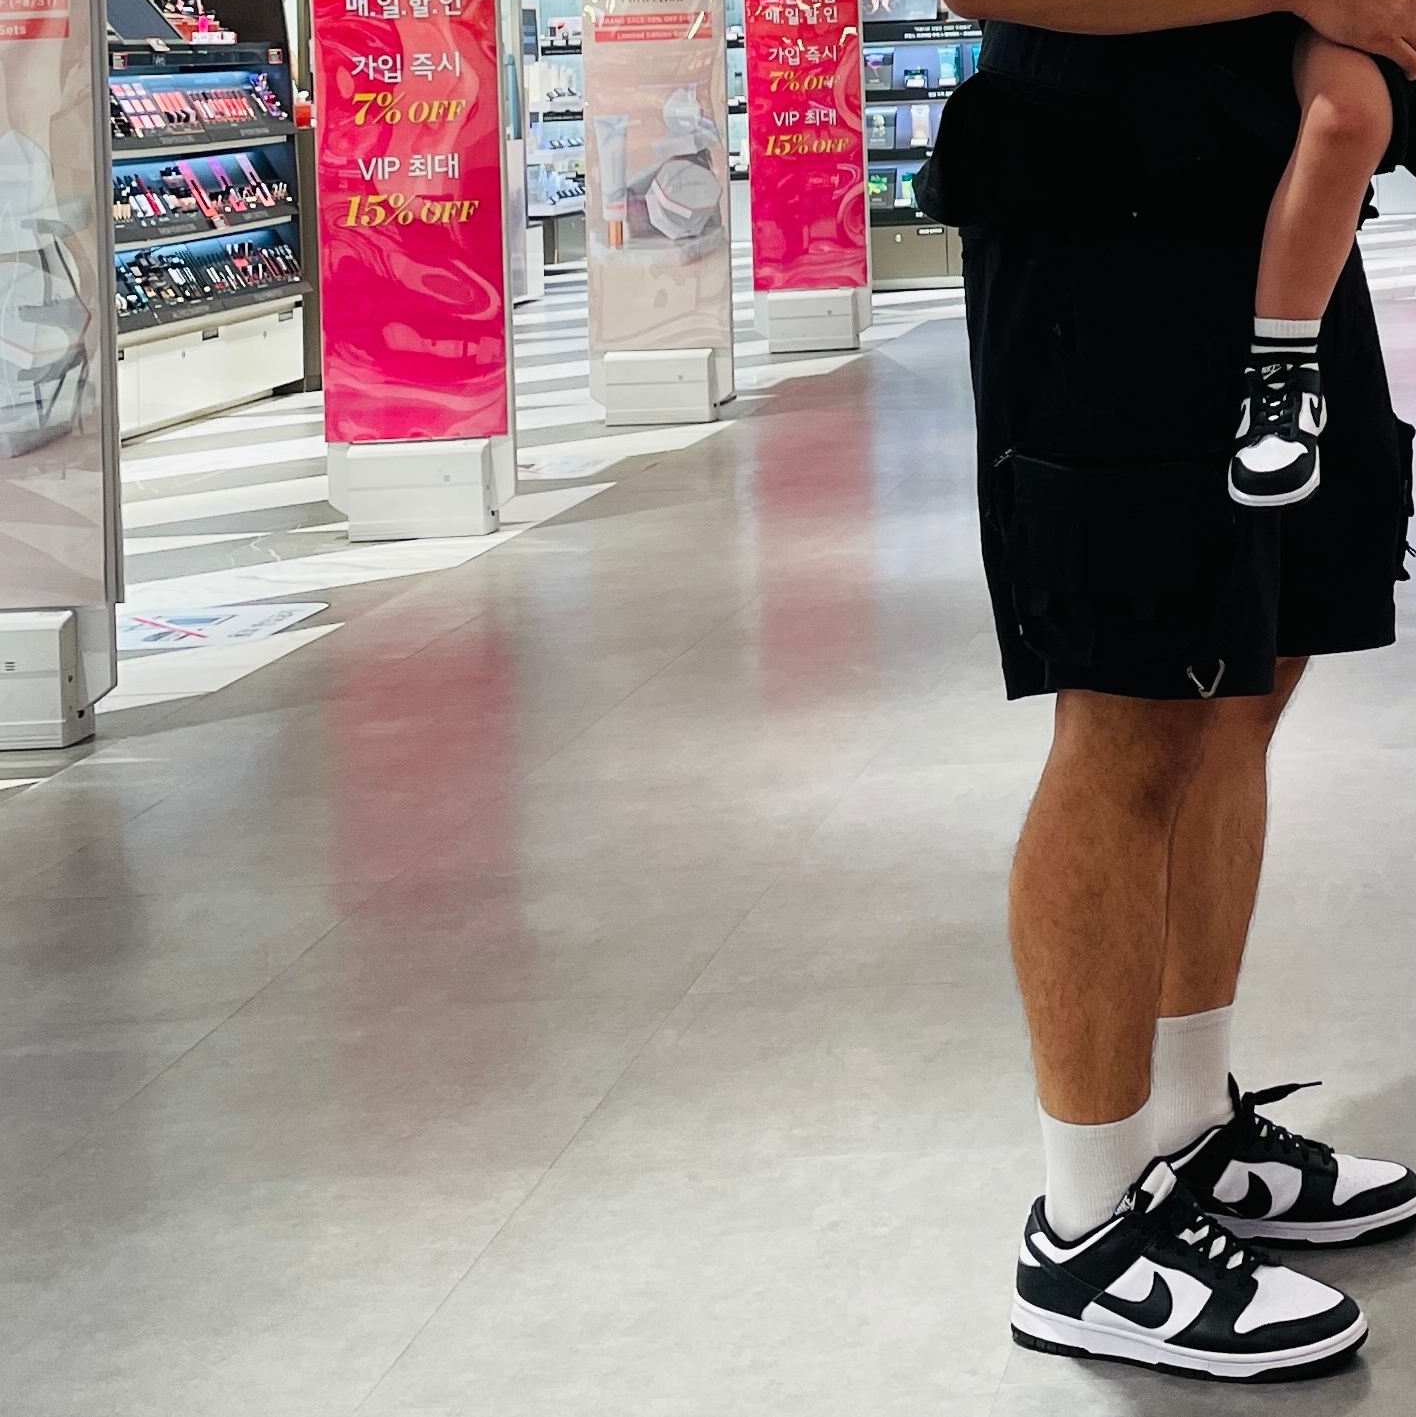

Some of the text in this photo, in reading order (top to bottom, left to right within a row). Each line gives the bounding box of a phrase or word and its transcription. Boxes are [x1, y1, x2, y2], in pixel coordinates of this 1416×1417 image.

[351, 51, 461, 83] 가입 즉시
[768, 45, 837, 66] 가입 즉시
[768, 70, 802, 92] 7%
[352, 92, 466, 125] 7% OFF
[773, 108, 837, 127] VIP 최대
[765, 134, 811, 156] 15%
[357, 153, 459, 181] VIP 최대
[345, 193, 479, 227] 15% OFF
